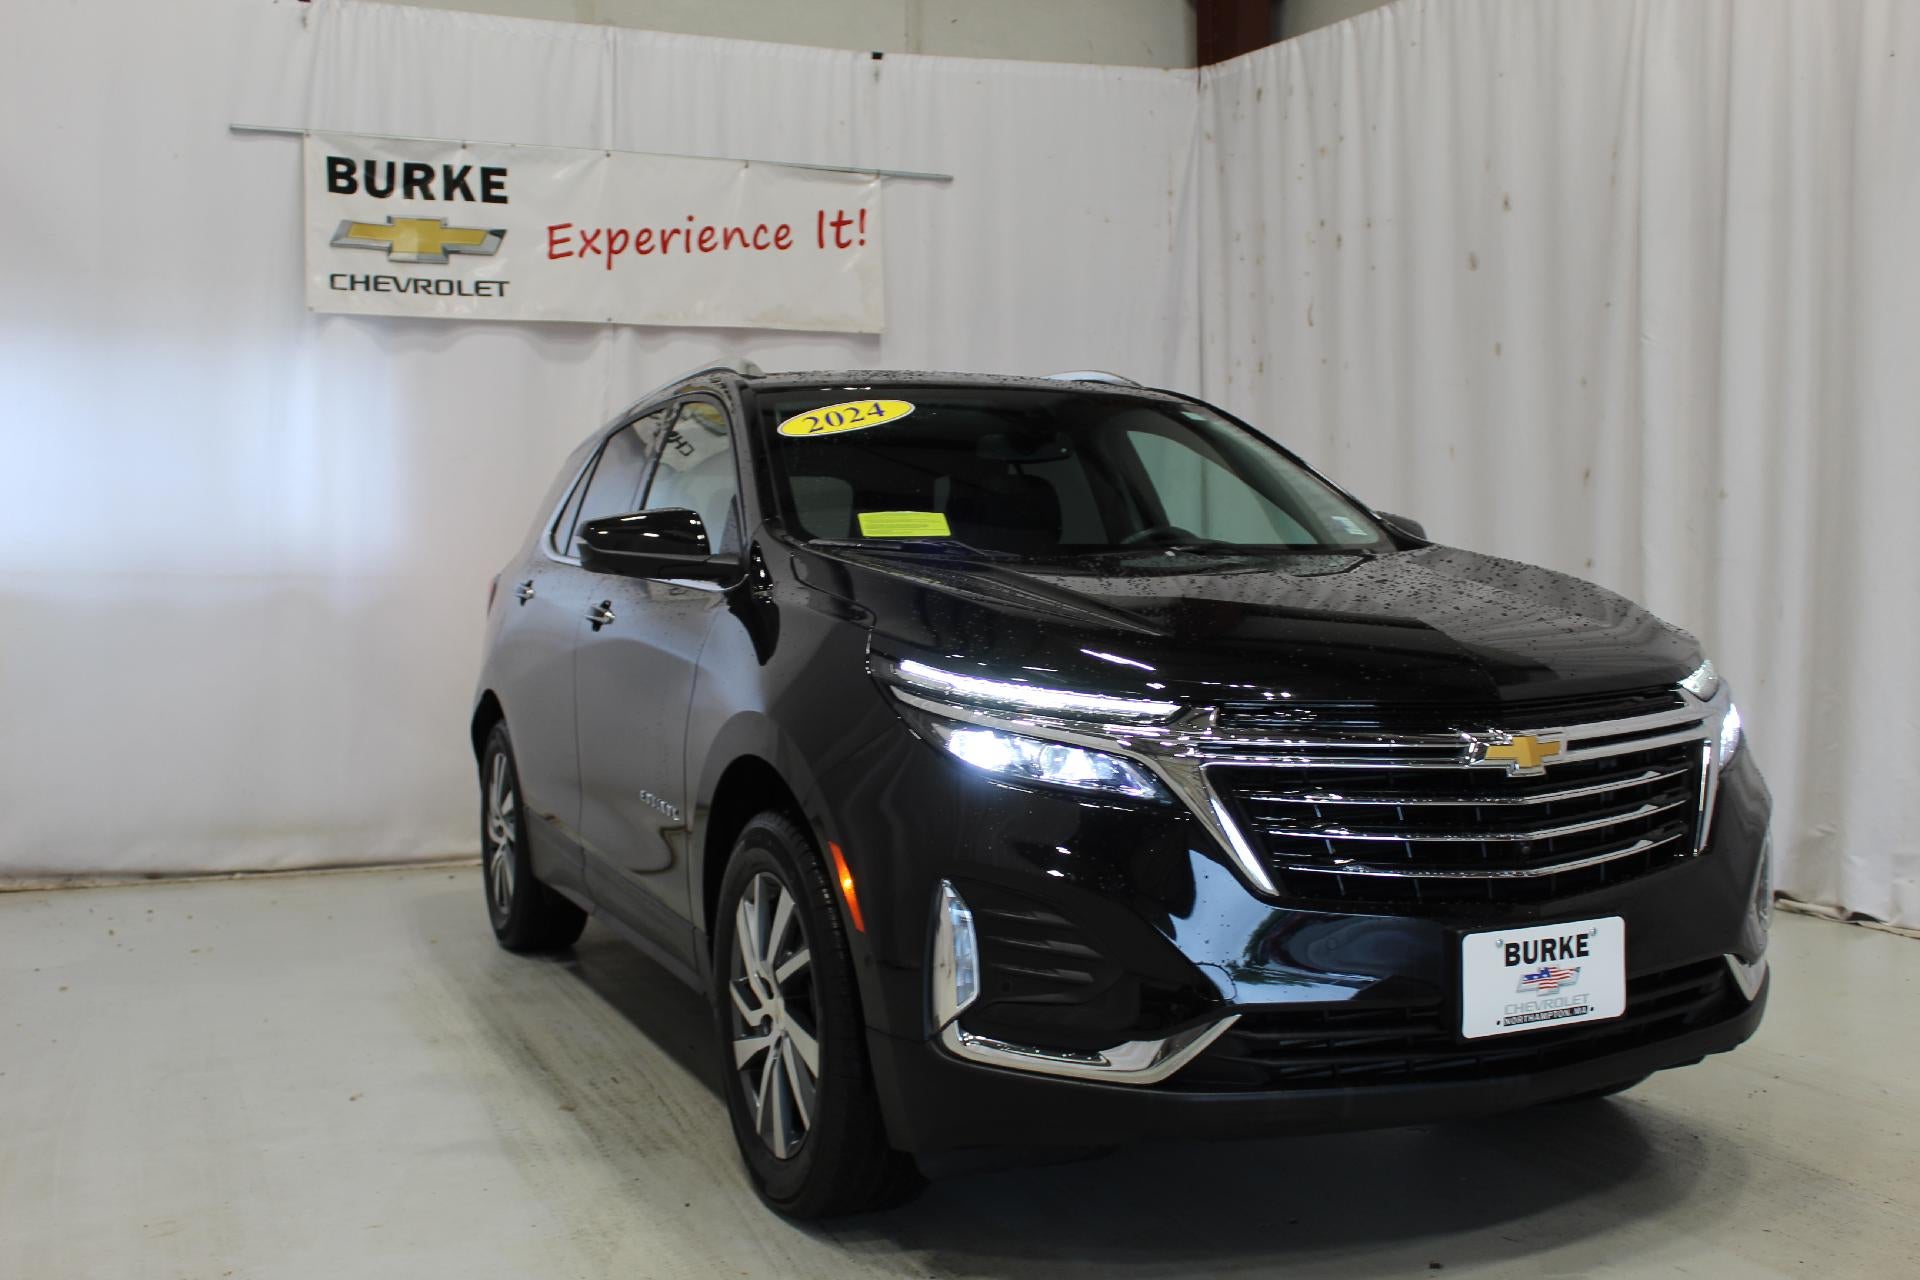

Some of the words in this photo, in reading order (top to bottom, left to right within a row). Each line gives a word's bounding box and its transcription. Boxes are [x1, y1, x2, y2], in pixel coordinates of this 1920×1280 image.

[326, 155, 509, 204] BURKE
[546, 215, 794, 270] Experience
[815, 208, 868, 249] It!
[329, 272, 511, 298] CHEVROLET
[802, 402, 886, 433] 2024
[1504, 933, 1590, 967] BURKE
[1503, 993, 1590, 1015] CHEVROLET
